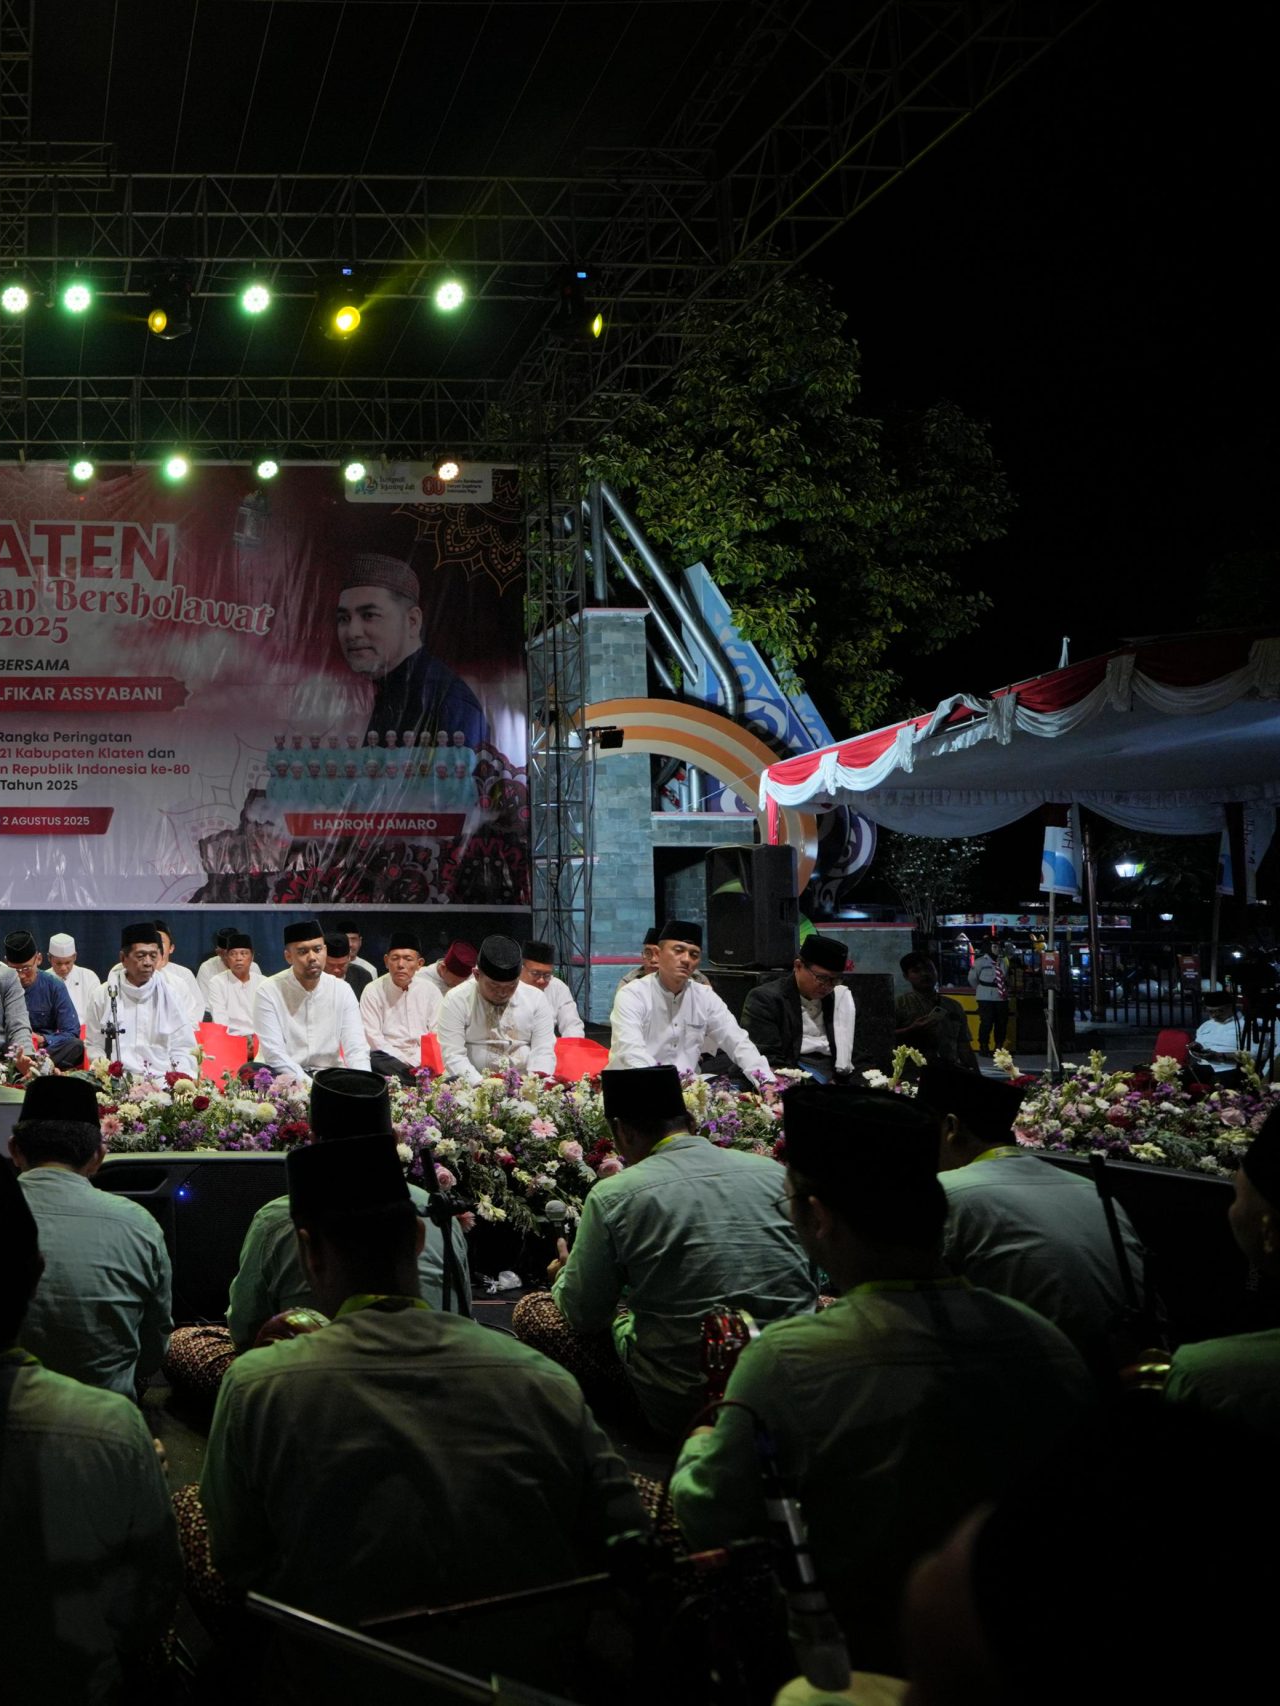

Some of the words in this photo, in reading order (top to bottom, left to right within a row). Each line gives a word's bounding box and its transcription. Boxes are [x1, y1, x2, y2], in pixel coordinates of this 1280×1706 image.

[46, 579, 276, 635] Bersholawat
[60, 686, 163, 701] ASSYABANI
[54, 731, 132, 746] Peringatan
[15, 748, 94, 762] Kabupaten
[98, 748, 144, 759] Klaten
[148, 748, 176, 759] dan
[12, 764, 74, 778] Republik
[77, 764, 147, 775] Indonesia
[151, 764, 190, 775] ke-80
[0, 779, 43, 791] Tahun
[46, 779, 78, 791] 2025
[2, 816, 9, 826] 2
[11, 815, 62, 826] AGUSTUS
[63, 815, 90, 826] 2025
[313, 818, 374, 830] HADROH
[378, 818, 438, 830] JAMARO
